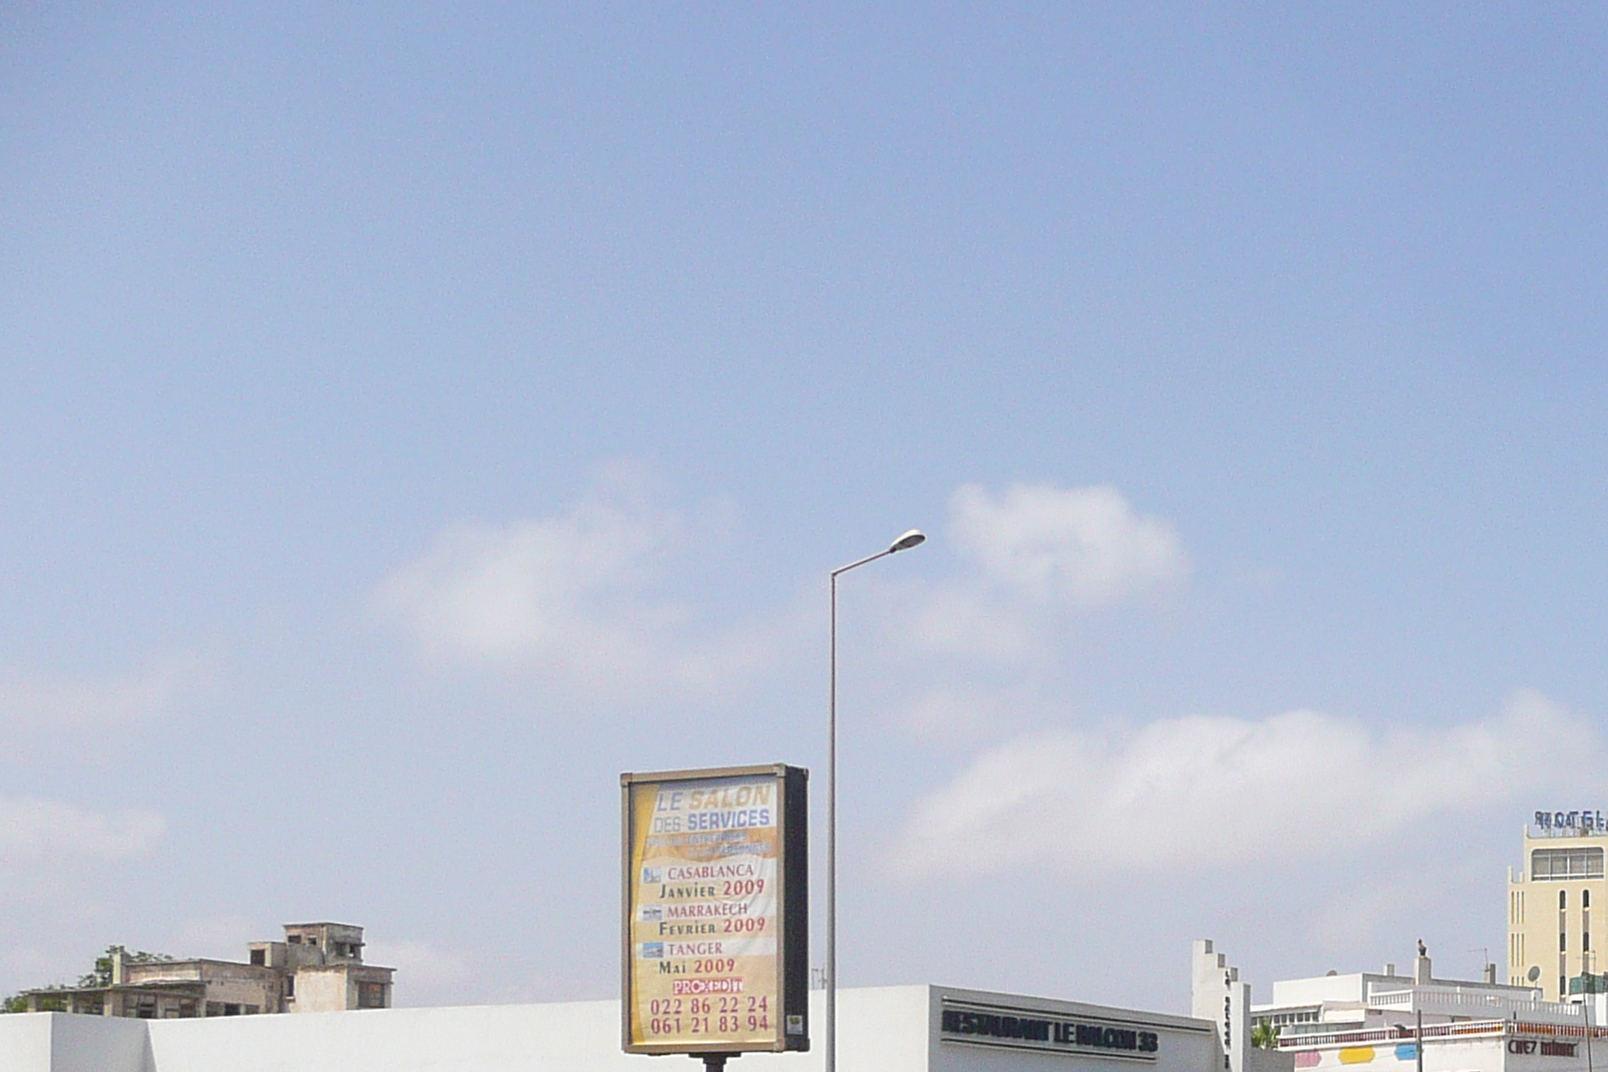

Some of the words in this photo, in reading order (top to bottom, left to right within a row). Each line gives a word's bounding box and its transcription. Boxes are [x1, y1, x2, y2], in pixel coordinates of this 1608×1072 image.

[657, 791, 683, 812] LE
[688, 785, 772, 811] SALON
[653, 816, 681, 833] DES
[687, 808, 770, 831] SERVICES
[667, 864, 754, 880] CASABLANCA
[723, 879, 765, 896] 2009
[666, 903, 748, 918] MARRAKECH
[723, 917, 766, 933] 2009
[668, 942, 723, 956] TANGER
[694, 958, 735, 973] 2009
[650, 999, 682, 1015] 022
[690, 998, 711, 1014] 86
[719, 996, 739, 1013] 22
[747, 995, 768, 1012] 24
[651, 1017, 681, 1034] 061
[691, 1016, 709, 1033] 21
[719, 1015, 740, 1032] 83
[747, 1014, 769, 1031] 94
[1054, 1022, 1075, 1043] LE
